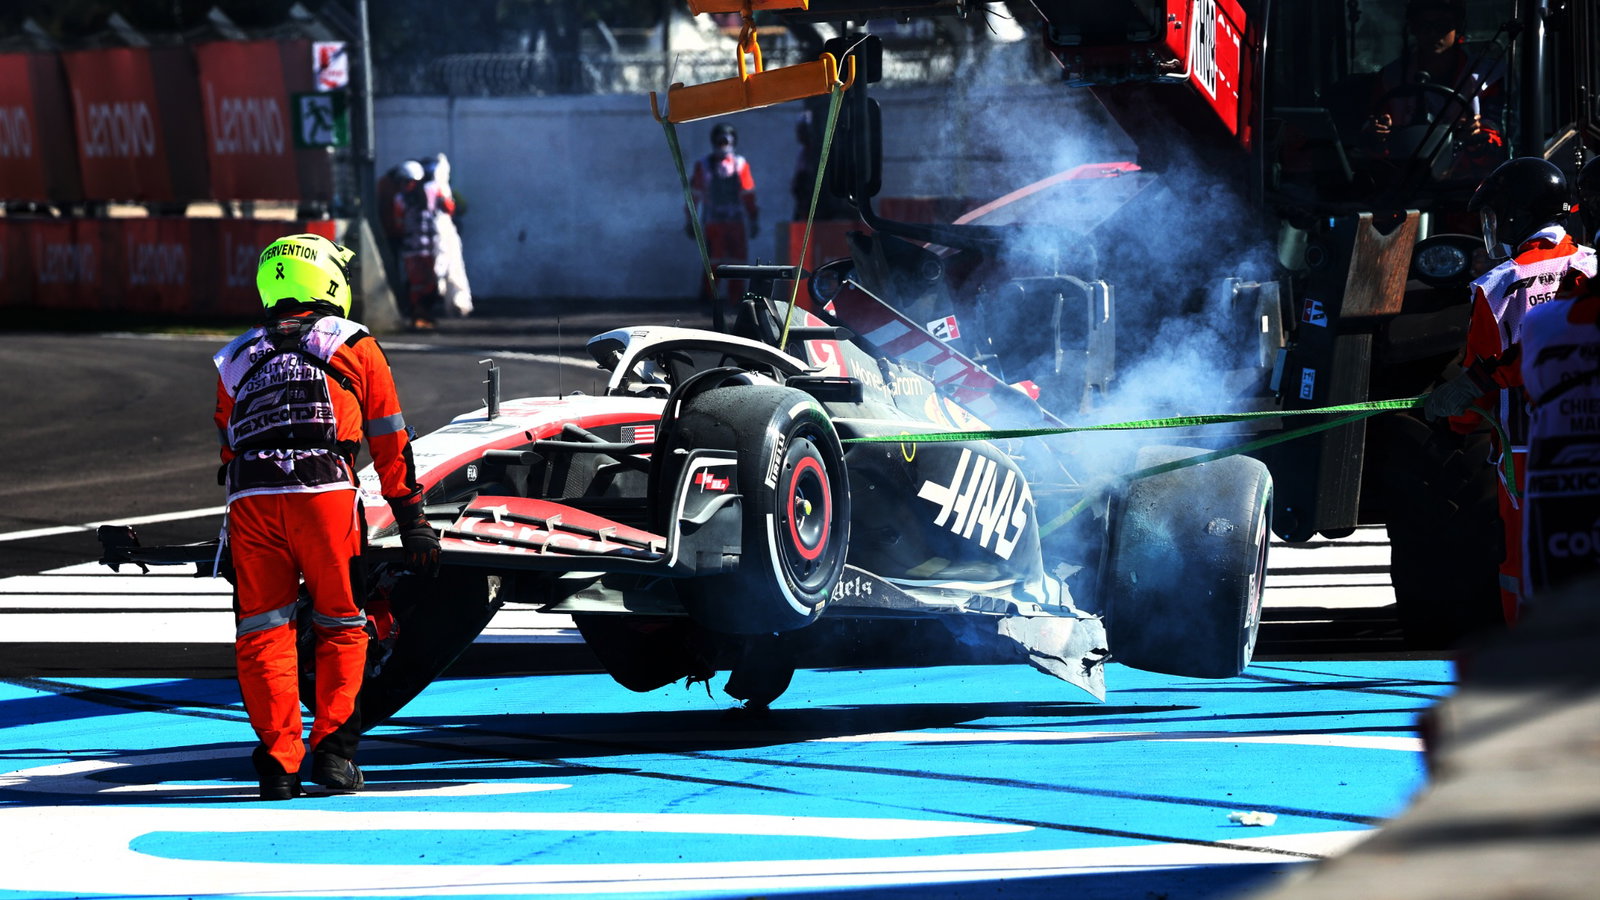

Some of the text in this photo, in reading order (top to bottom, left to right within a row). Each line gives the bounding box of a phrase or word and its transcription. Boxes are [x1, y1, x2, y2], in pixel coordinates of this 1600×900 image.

[74, 89, 155, 158] Lenovo
[207, 82, 284, 156] Lenovo
[917, 448, 1034, 560] HAAS
